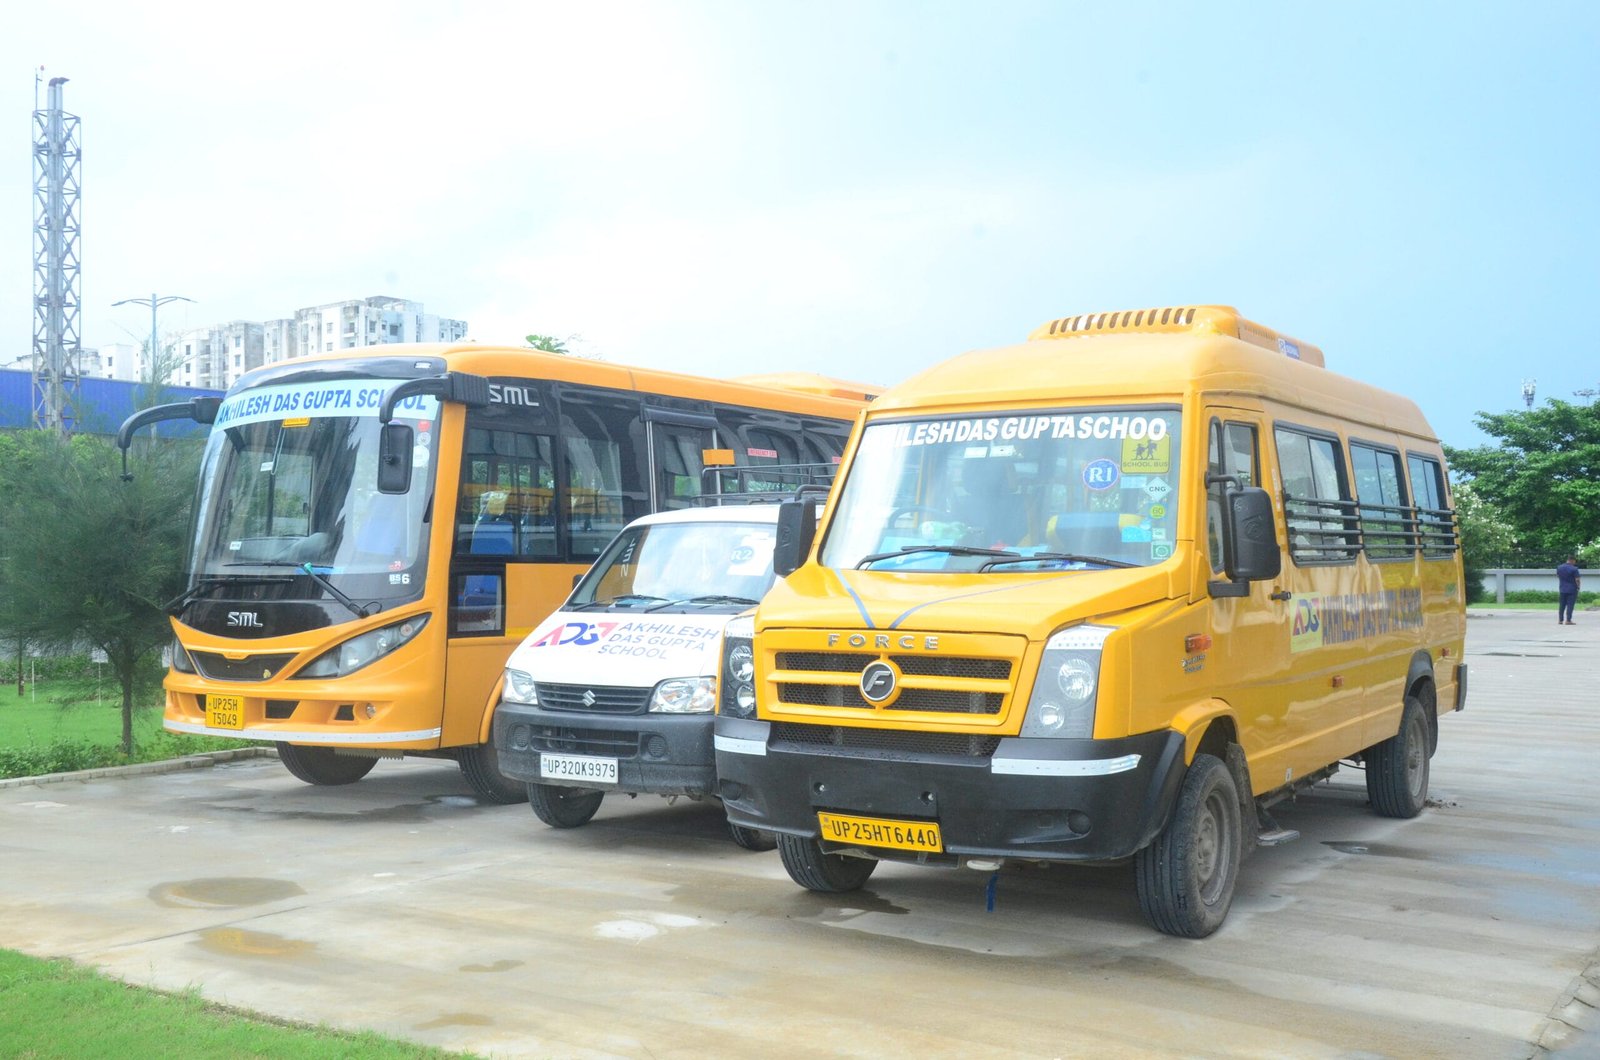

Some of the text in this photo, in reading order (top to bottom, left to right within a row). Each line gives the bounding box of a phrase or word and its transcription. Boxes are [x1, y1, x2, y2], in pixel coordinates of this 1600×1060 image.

[217, 389, 426, 425] AKHILESH DAS GUPTA SCOL
[1001, 416, 1075, 440] GUPTA
[227, 611, 264, 627] SML
[619, 622, 721, 640] AKHILESH
[608, 633, 706, 652] DAS GUPTA
[828, 633, 939, 650] FORCE
[598, 644, 668, 660] SCHOOL
[212, 697, 238, 711] UP25H
[212, 712, 237, 727] T5049
[547, 759, 616, 778] UP32QK9979
[831, 820, 937, 847] UP25HT6440
